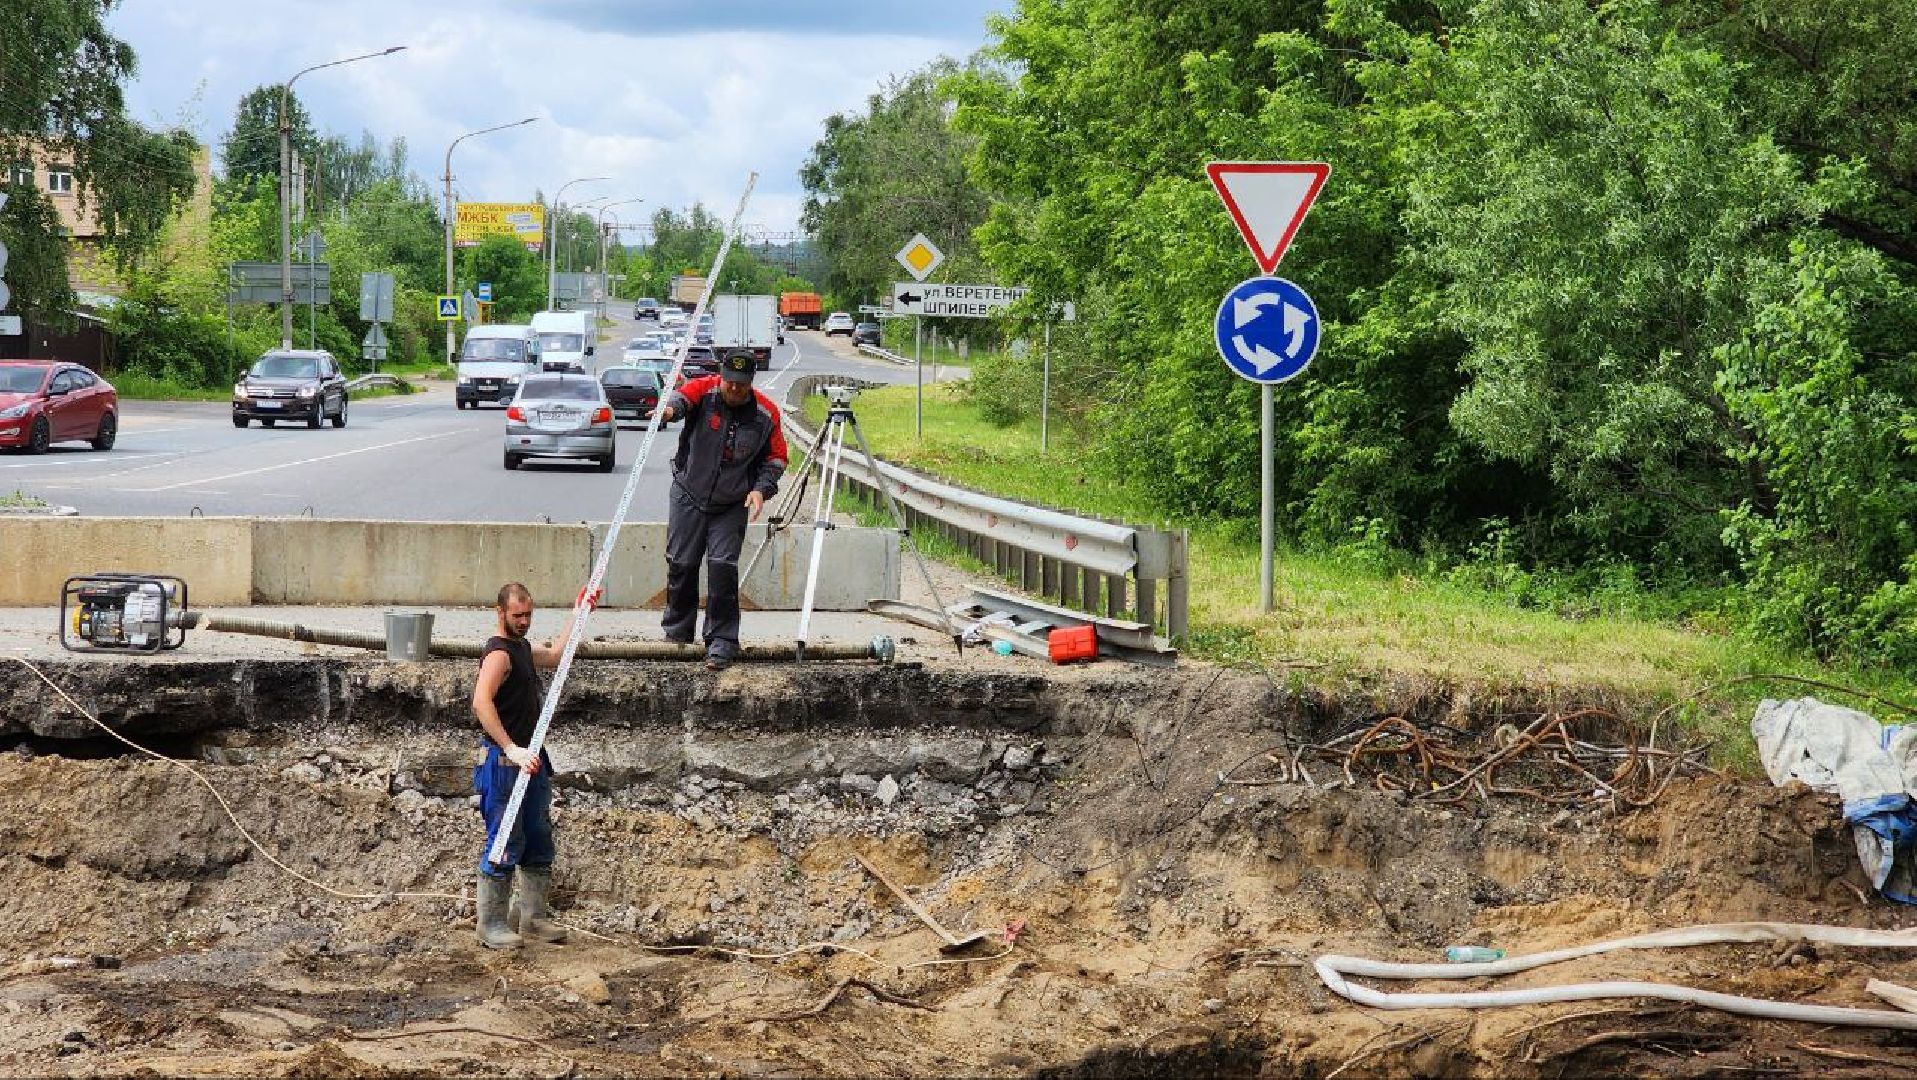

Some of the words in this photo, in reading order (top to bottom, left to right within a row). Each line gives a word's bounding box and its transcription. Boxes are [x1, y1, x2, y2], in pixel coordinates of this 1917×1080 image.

[458, 212, 498, 223] МЖБК
[924, 287, 1027, 300] ул.ВЕРЕТЕНН
[924, 302, 998, 314] ШПИЛЕВ
